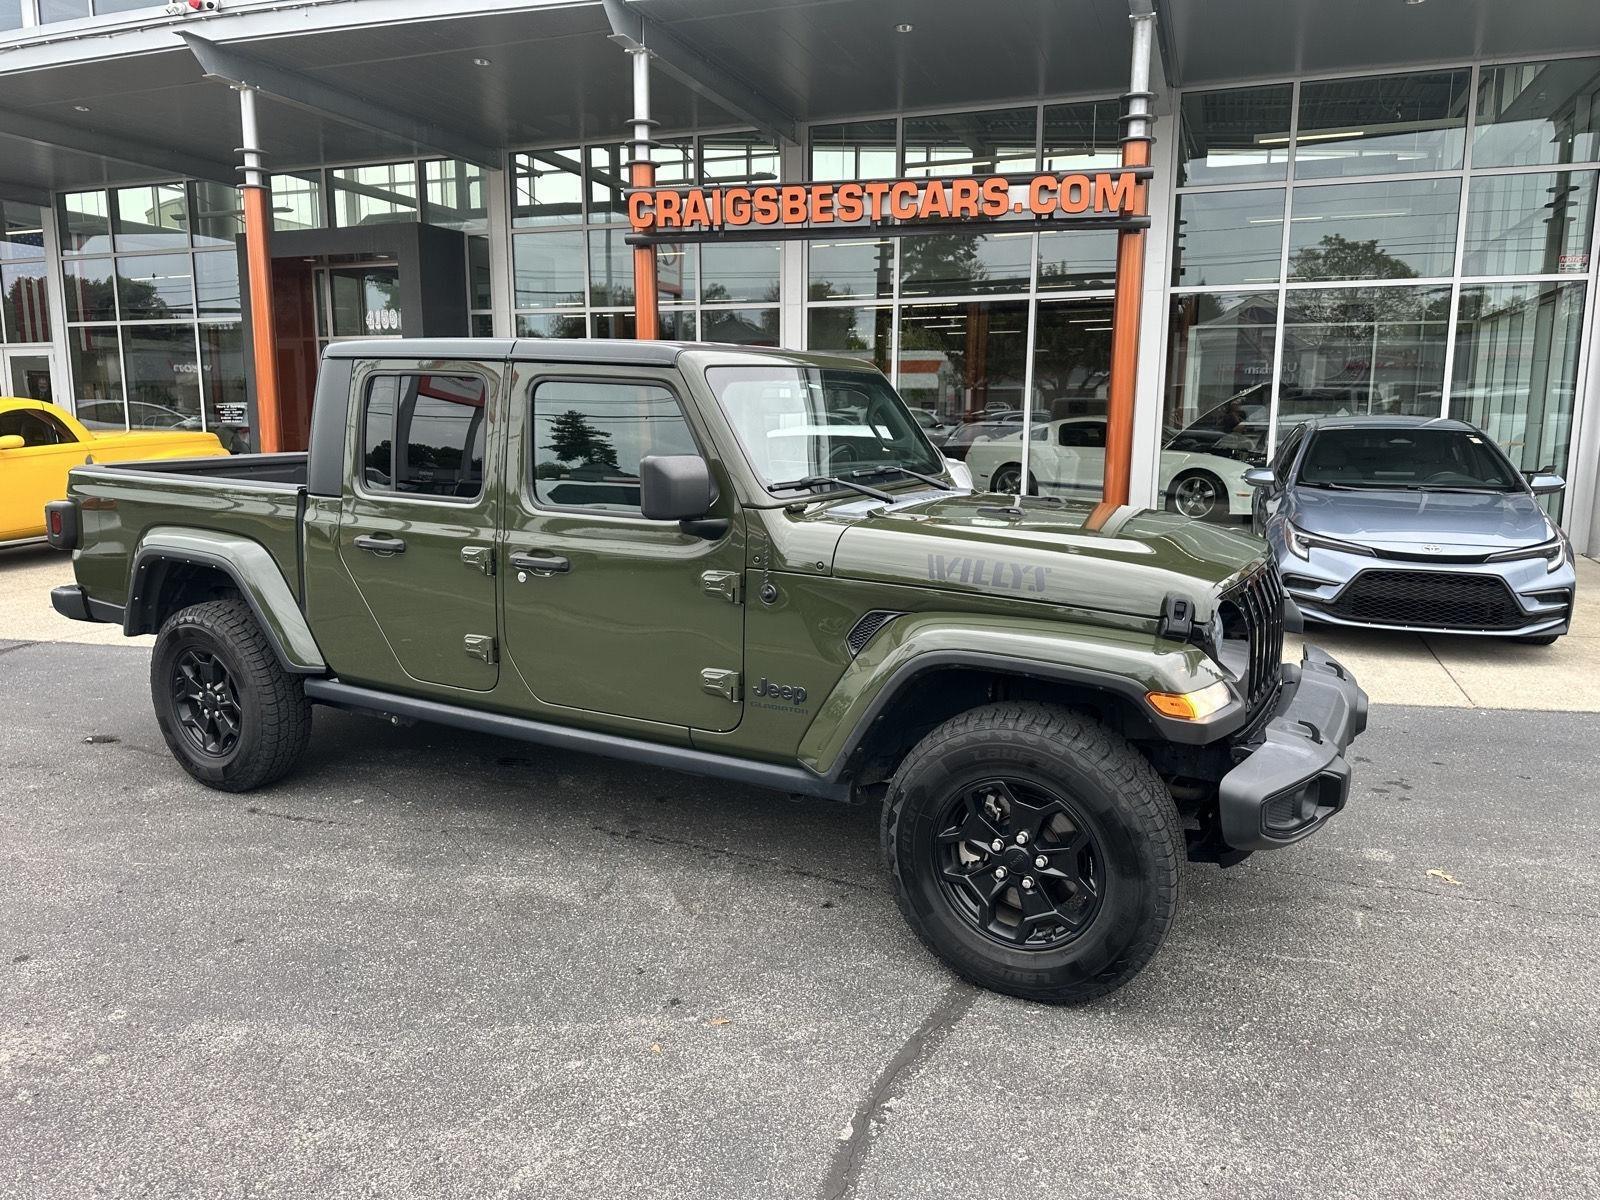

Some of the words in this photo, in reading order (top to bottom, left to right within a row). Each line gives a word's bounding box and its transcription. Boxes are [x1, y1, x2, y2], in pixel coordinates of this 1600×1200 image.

[628, 172, 1136, 229] CRAIGSBESTCARS.COM
[927, 554, 1052, 592] WILLYS
[752, 677, 808, 705] Jeep
[750, 701, 809, 715] GLADIATOR
